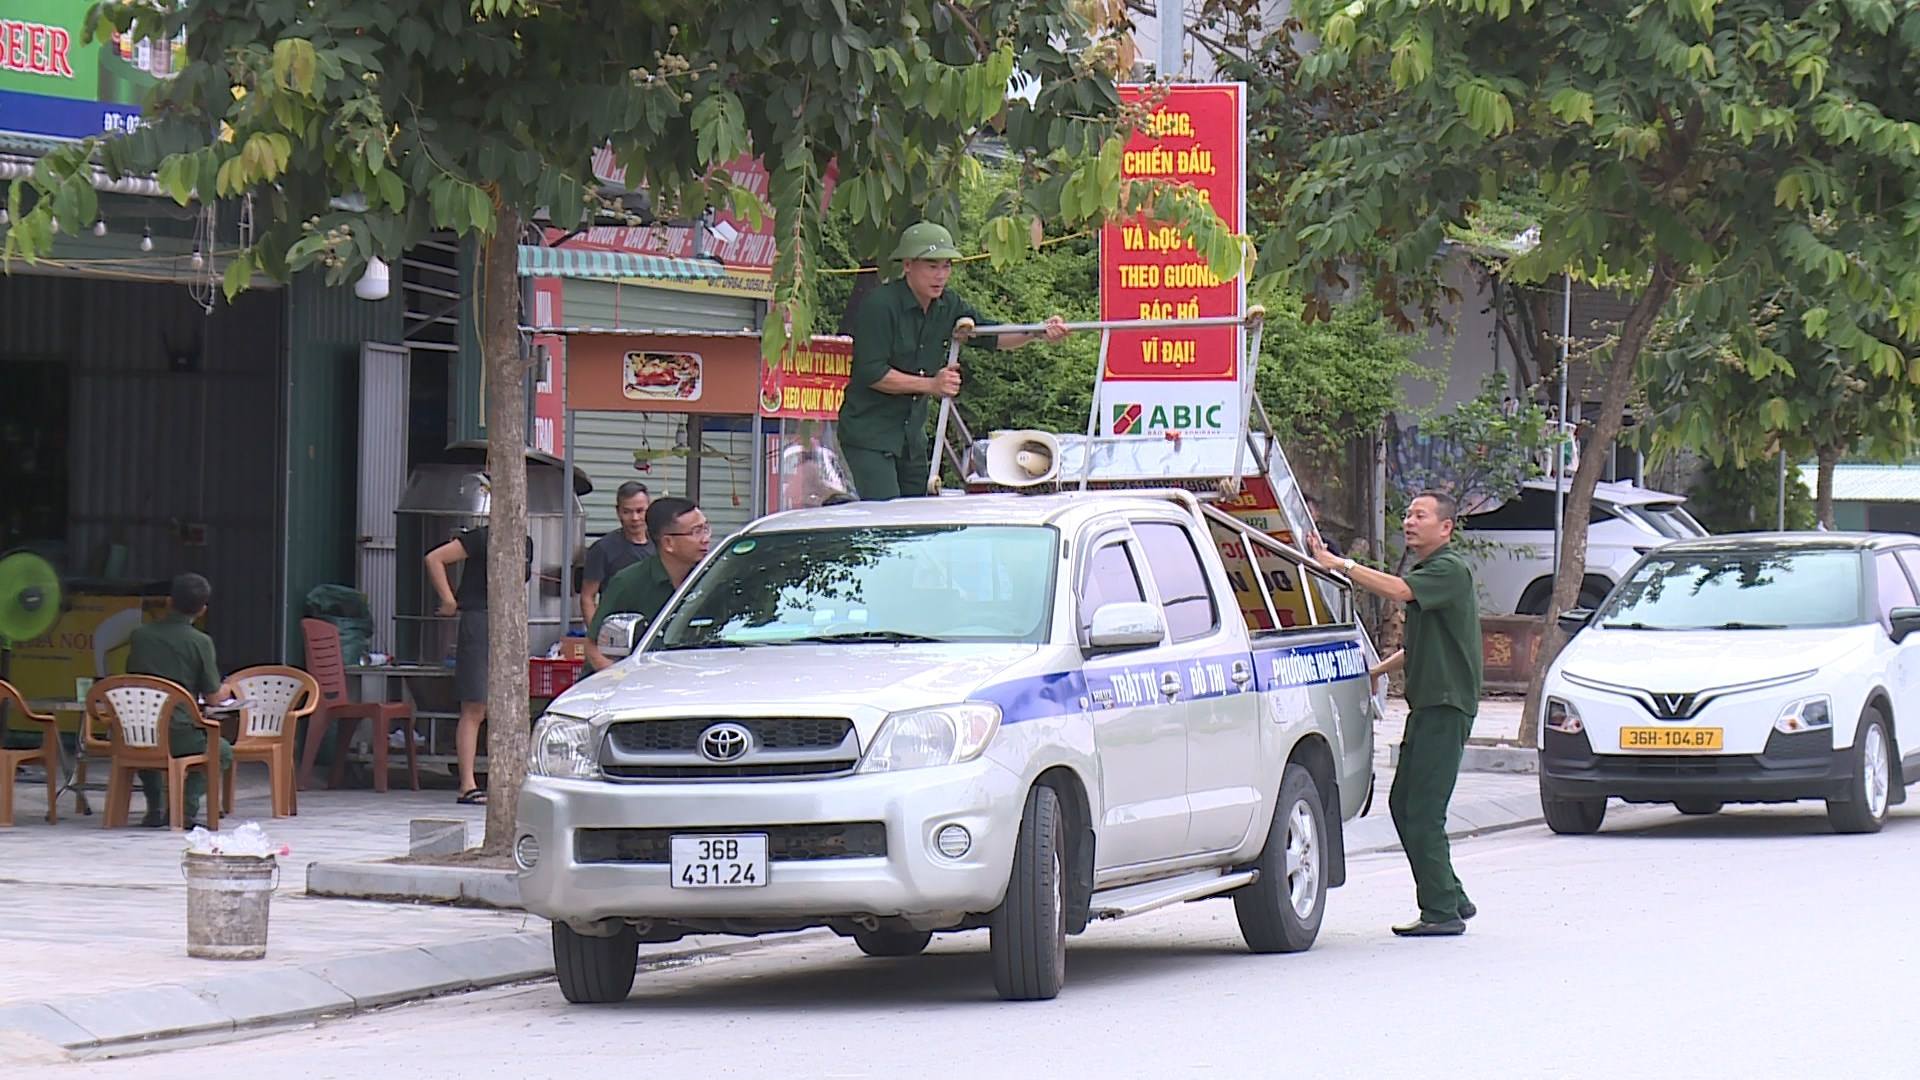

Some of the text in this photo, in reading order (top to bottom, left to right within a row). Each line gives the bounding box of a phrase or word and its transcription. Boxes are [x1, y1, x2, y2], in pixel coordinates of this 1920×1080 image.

[0, 20, 72, 78] EER
[1123, 142, 1216, 176] CHIẾN ĐẤU,
[1123, 222, 1145, 250] VÀ
[1119, 265, 1160, 289] THEO
[1140, 298, 1173, 321] BÁC
[1142, 337, 1196, 369] VĨ ĐẠI!
[783, 386, 800, 410] HEO
[1148, 404, 1222, 429] ABIC
[1271, 648, 1319, 686] PHƯỜNG
[1315, 651, 1338, 683] HẠC
[1110, 667, 1143, 706] TRẬT
[1142, 668, 1159, 705] TỰ
[1189, 659, 1207, 696] ĐÔ
[1206, 663, 1227, 696] THỊ
[1629, 730, 1714, 746] 36H-104.87
[698, 839, 739, 860] 36B
[682, 863, 756, 885] 431.24
